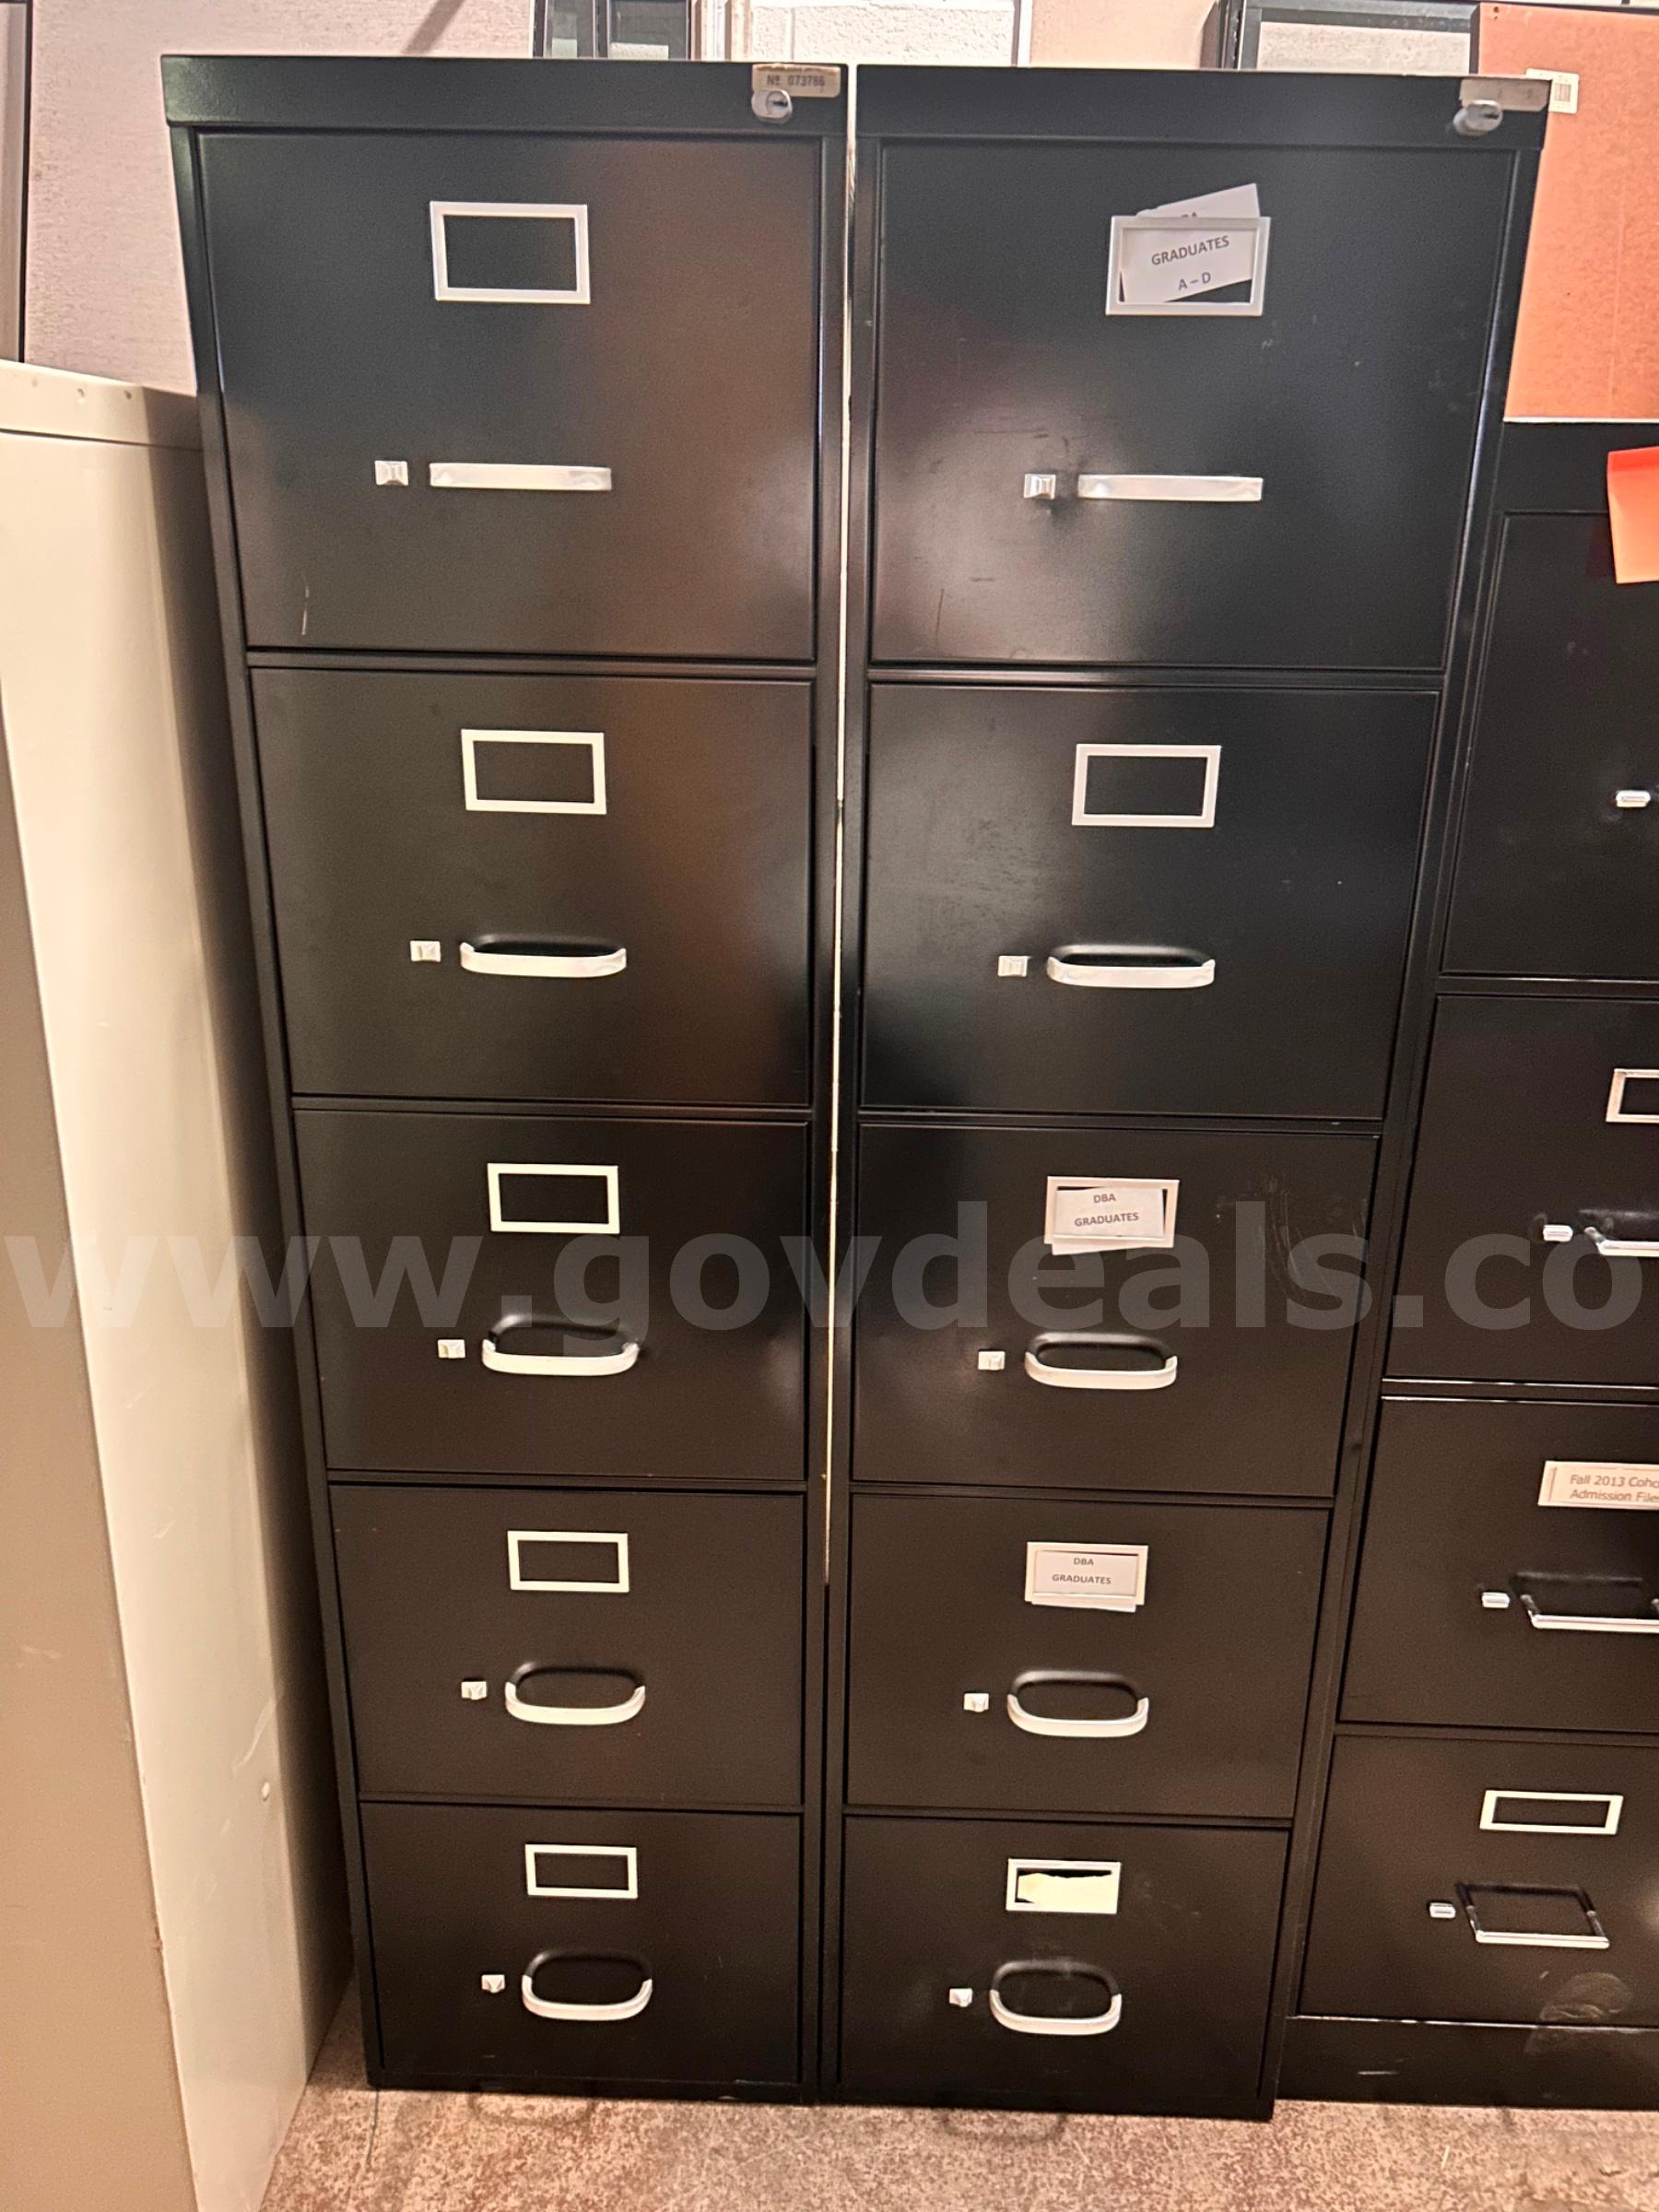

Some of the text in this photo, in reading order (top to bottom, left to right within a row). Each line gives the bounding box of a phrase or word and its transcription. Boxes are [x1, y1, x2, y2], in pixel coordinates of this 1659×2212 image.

[1151, 235, 1230, 265] GRADUATES
[1178, 278, 1188, 290] A
[1202, 272, 1211, 284] D
[1093, 1193, 1117, 1204] DBA
[1074, 1212, 1139, 1227] GRADUATES
[1570, 1475, 1592, 1485] Fall
[1594, 1475, 1626, 1487] 2013
[1570, 1488, 1632, 1501] Admission
[1073, 1557, 1094, 1566] DBA
[1052, 1573, 1112, 1584] GRADUATES
